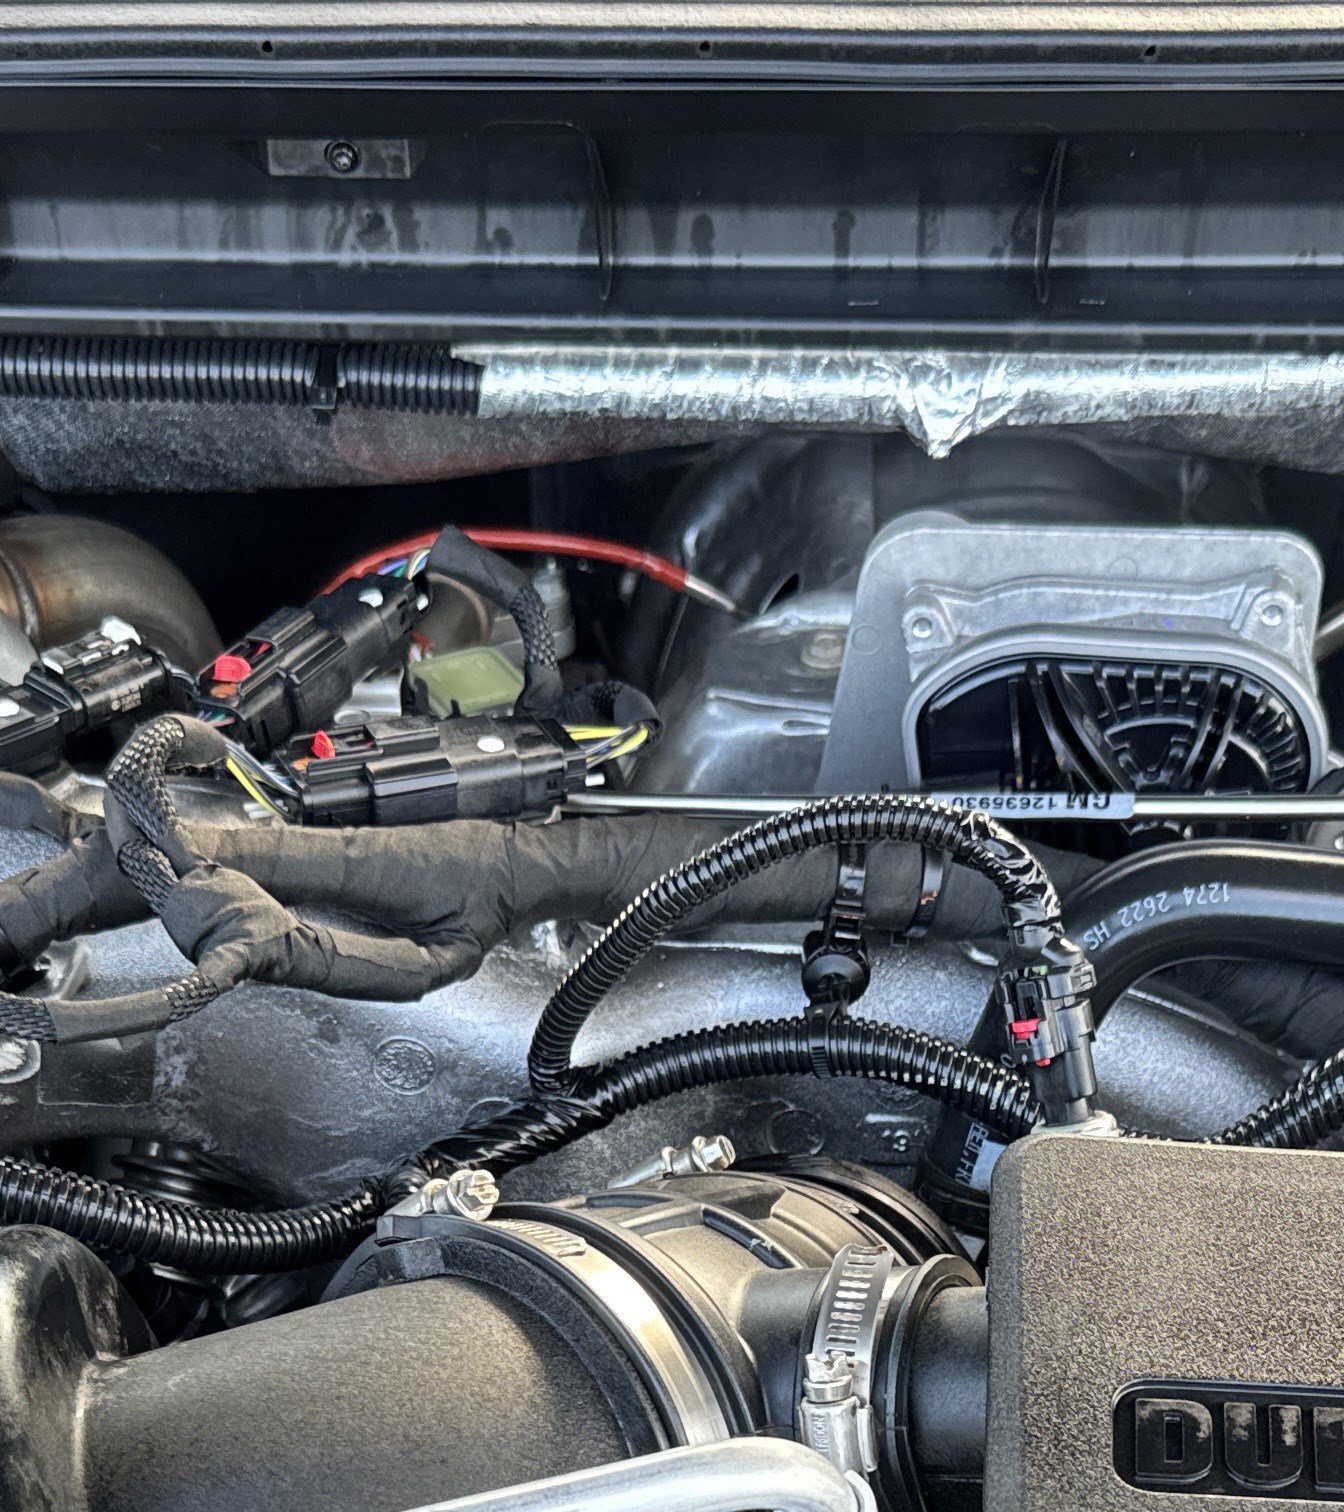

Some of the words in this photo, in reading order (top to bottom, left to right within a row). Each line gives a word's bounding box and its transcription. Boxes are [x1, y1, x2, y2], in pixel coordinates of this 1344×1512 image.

[1067, 794, 1111, 811] GM
[1116, 891, 1170, 929] 2622
[1083, 920, 1112, 951] HS
